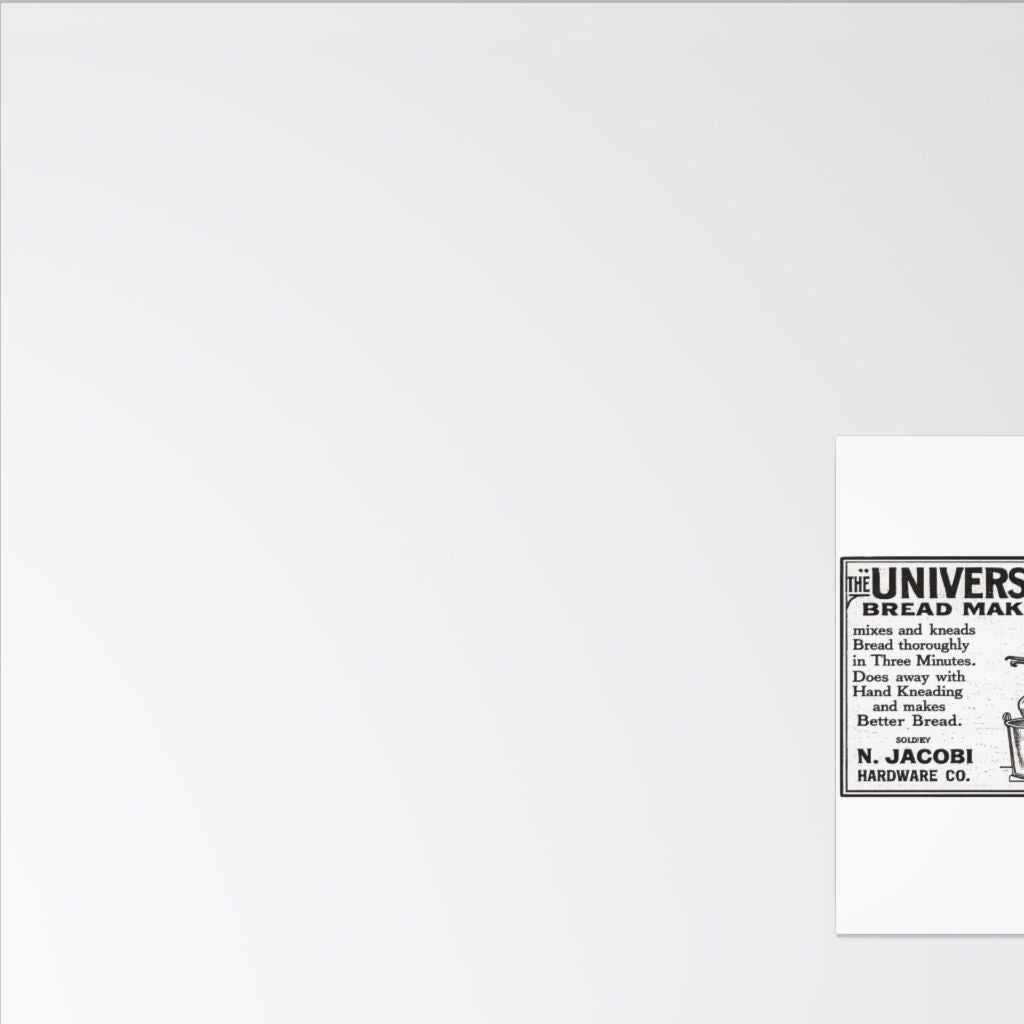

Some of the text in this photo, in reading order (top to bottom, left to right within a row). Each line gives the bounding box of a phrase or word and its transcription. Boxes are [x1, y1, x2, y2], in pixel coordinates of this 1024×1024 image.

[847, 576, 870, 593] THE
[863, 603, 953, 616] BREAD
[853, 624, 976, 635] mixes and kneads
[853, 638, 970, 653] Bread thoroughly
[853, 654, 976, 666] in Three Minutes.
[853, 671, 966, 684] Does away with
[853, 686, 963, 699] Hand Kneading
[873, 700, 946, 712] and makes
[857, 714, 962, 726] Better Bread.
[857, 749, 973, 764] N. JACOBI
[857, 770, 970, 782] HARDWARE CO.
